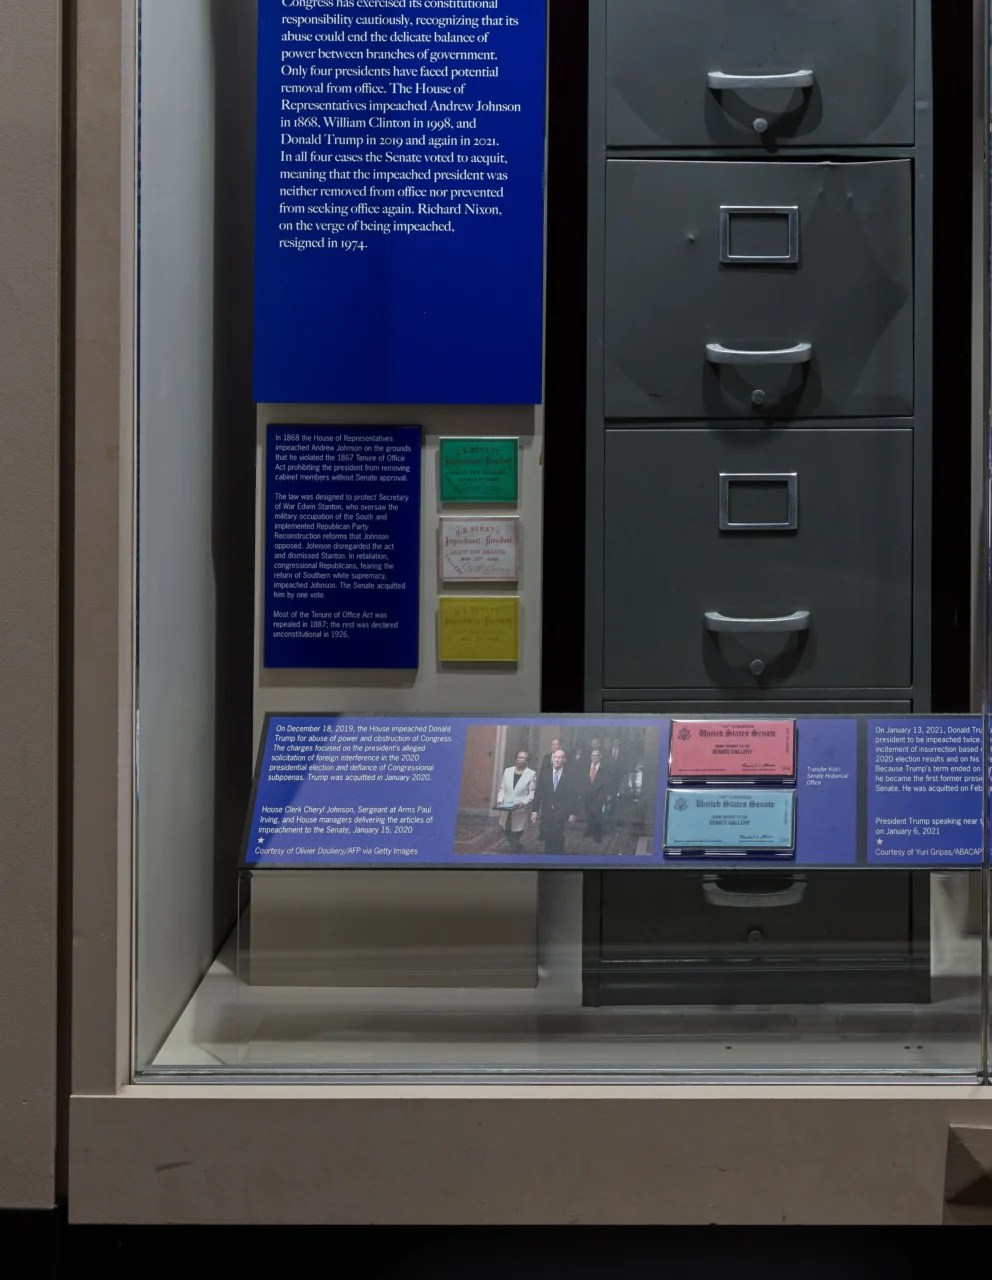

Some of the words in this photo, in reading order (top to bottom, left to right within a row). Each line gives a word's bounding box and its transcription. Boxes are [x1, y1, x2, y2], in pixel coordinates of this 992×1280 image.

[280, 115, 291, 128] in
[294, 115, 321, 130] 1868,
[323, 115, 366, 128] William
[368, 115, 411, 128] Clinton
[413, 116, 424, 128] in
[427, 116, 454, 132] 1998,
[456, 116, 477, 129] and
[279, 235, 325, 251] resigned
[327, 235, 338, 248] in
[341, 239, 368, 252] 1974.
[275, 434, 282, 442] In
[283, 434, 301, 442] 1868
[301, 434, 312, 442] the
[313, 434, 334, 442] House
[335, 434, 343, 442] of
[343, 434, 394, 444] Representatives
[272, 630, 322, 638] unconstitutional
[323, 630, 330, 638] in
[331, 630, 350, 638] 1926.
[275, 724, 286, 732] On
[286, 724, 320, 732] December
[322, 724, 333, 734] 18,
[334, 724, 355, 734] 2019,
[356, 724, 368, 732] the
[368, 724, 390, 732] House
[390, 724, 427, 734] impeached
[427, 724, 451, 732] Donald
[875, 783, 901, 792] Senate.
[902, 783, 912, 792] He
[928, 783, 959, 794] acquitted
[885, 827, 912, 837] January
[913, 827, 921, 836] 6,
[922, 827, 940, 835] 2021
